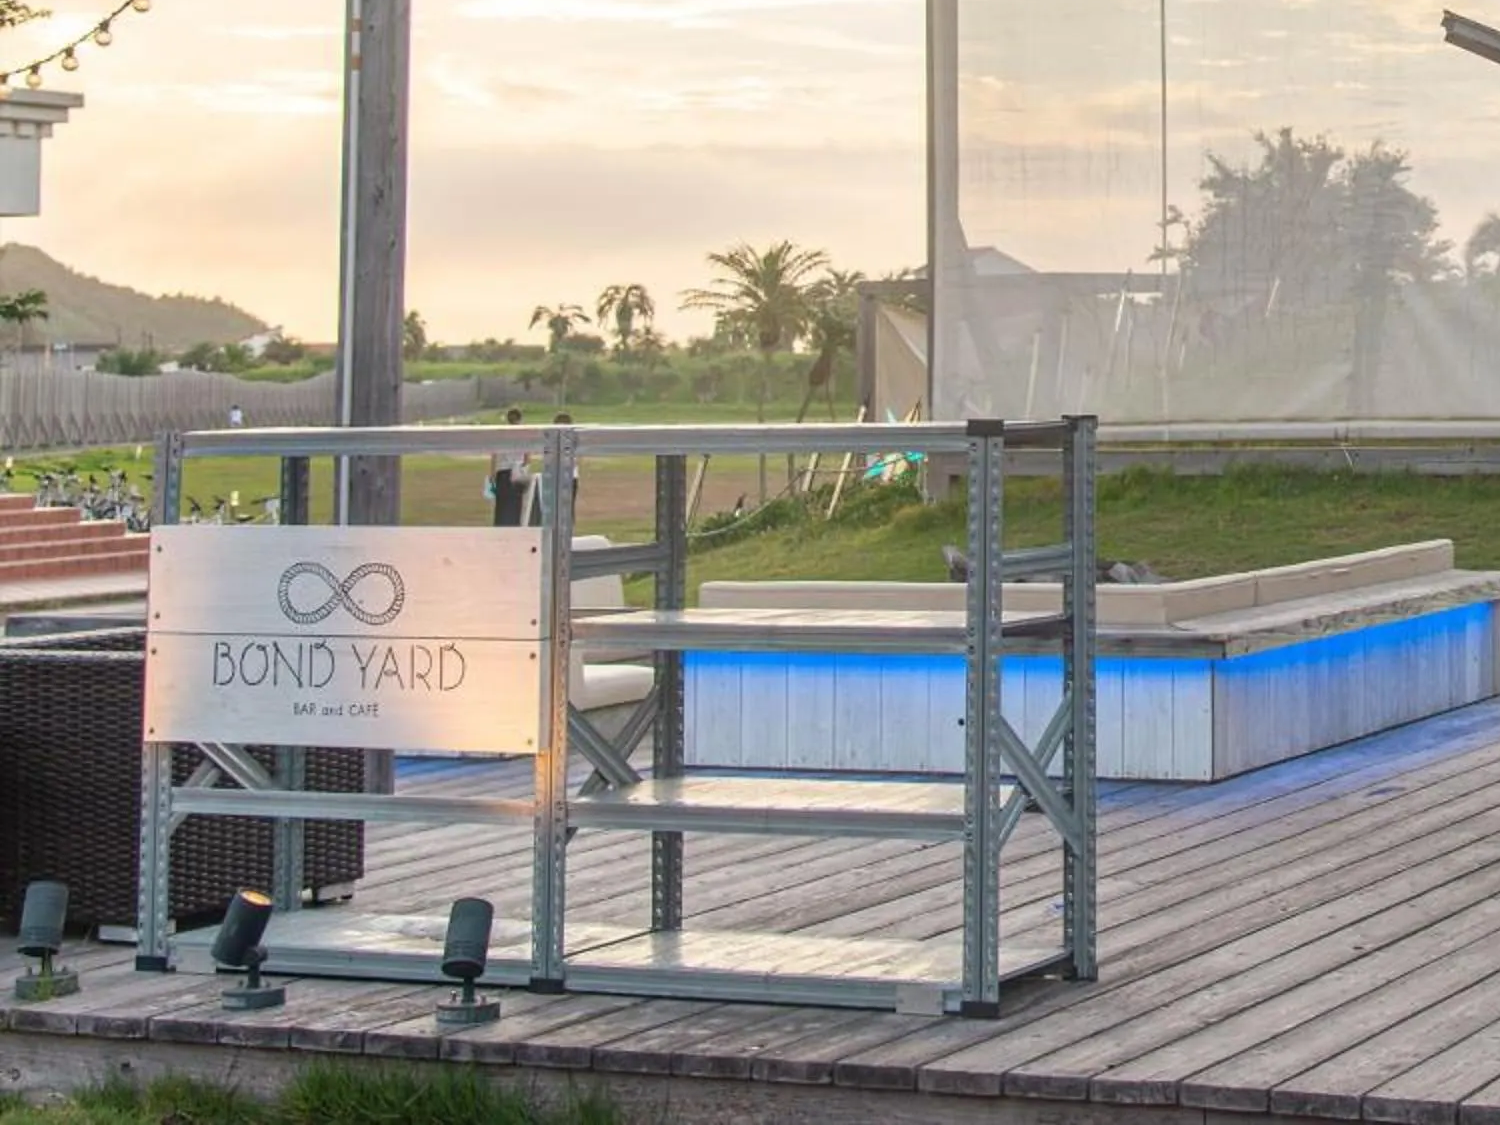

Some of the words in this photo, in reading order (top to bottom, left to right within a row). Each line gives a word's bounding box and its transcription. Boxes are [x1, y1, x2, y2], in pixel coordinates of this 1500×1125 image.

[213, 639, 335, 689] BOND
[352, 641, 466, 691] YARD
[293, 702, 317, 716] BAR
[321, 704, 343, 716] and
